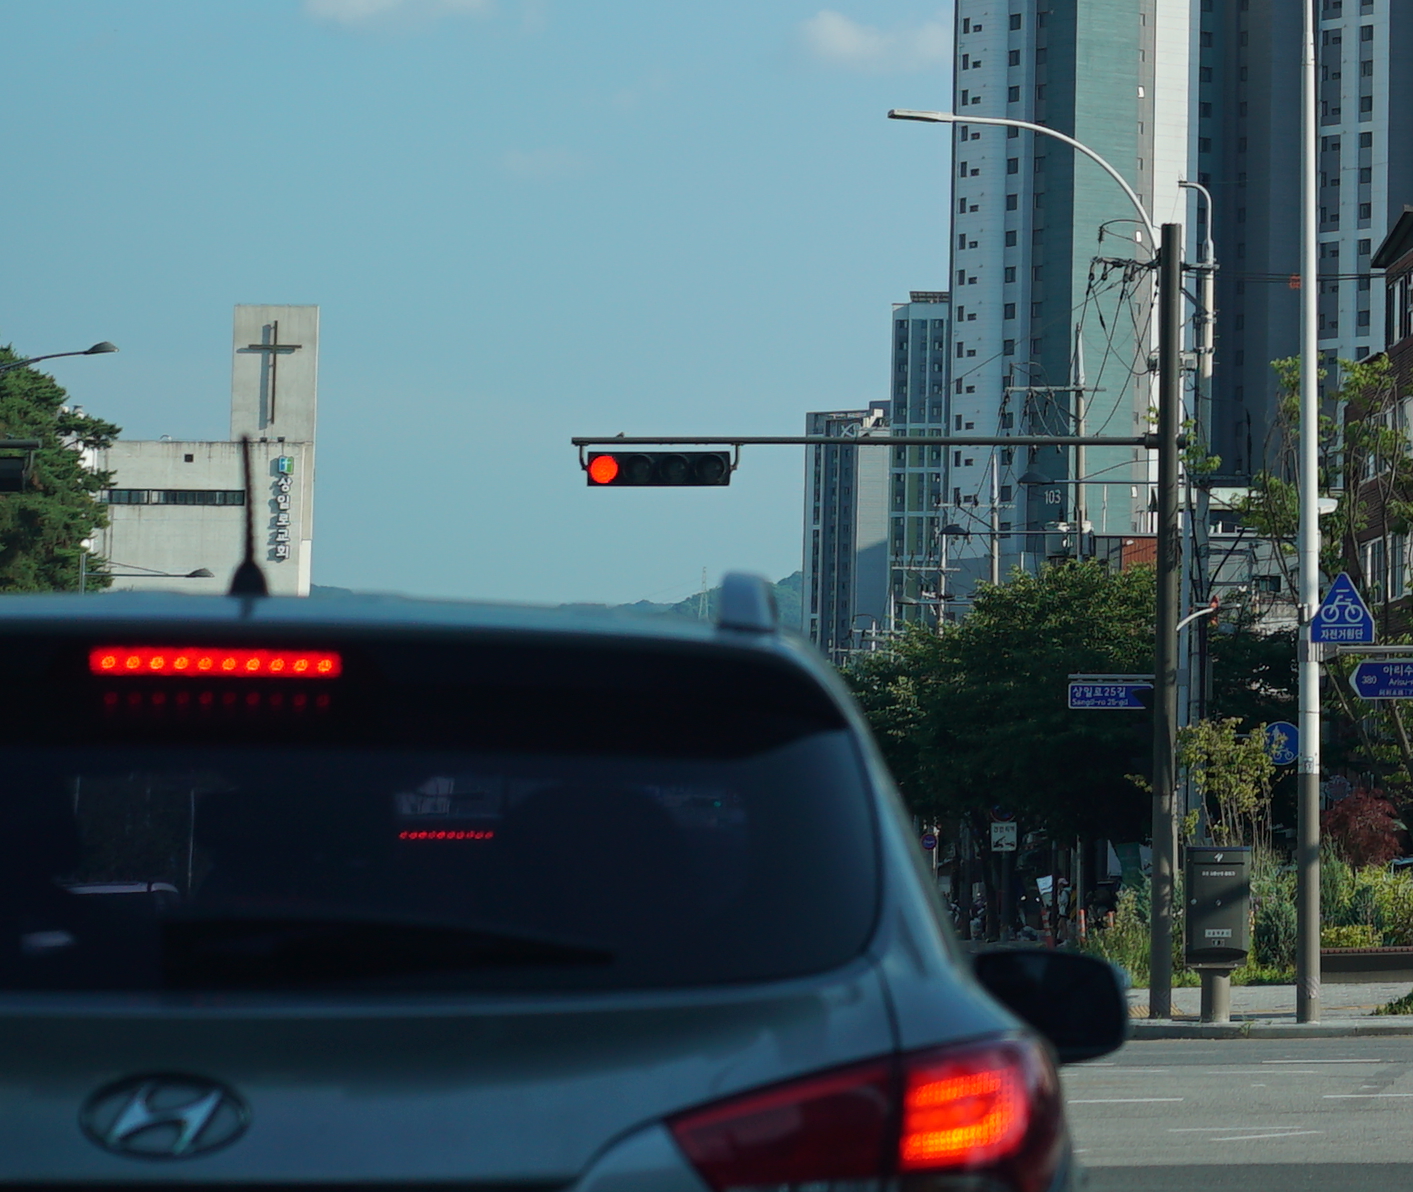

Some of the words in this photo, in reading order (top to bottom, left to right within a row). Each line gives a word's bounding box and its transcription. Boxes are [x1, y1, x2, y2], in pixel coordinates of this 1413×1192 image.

[1044, 489, 1061, 505] 103
[276, 477, 292, 560] 상일로교회
[1320, 628, 1364, 640] 자전거횡단
[1361, 675, 1377, 684] 380
[1072, 687, 1126, 698] 상일로25길
